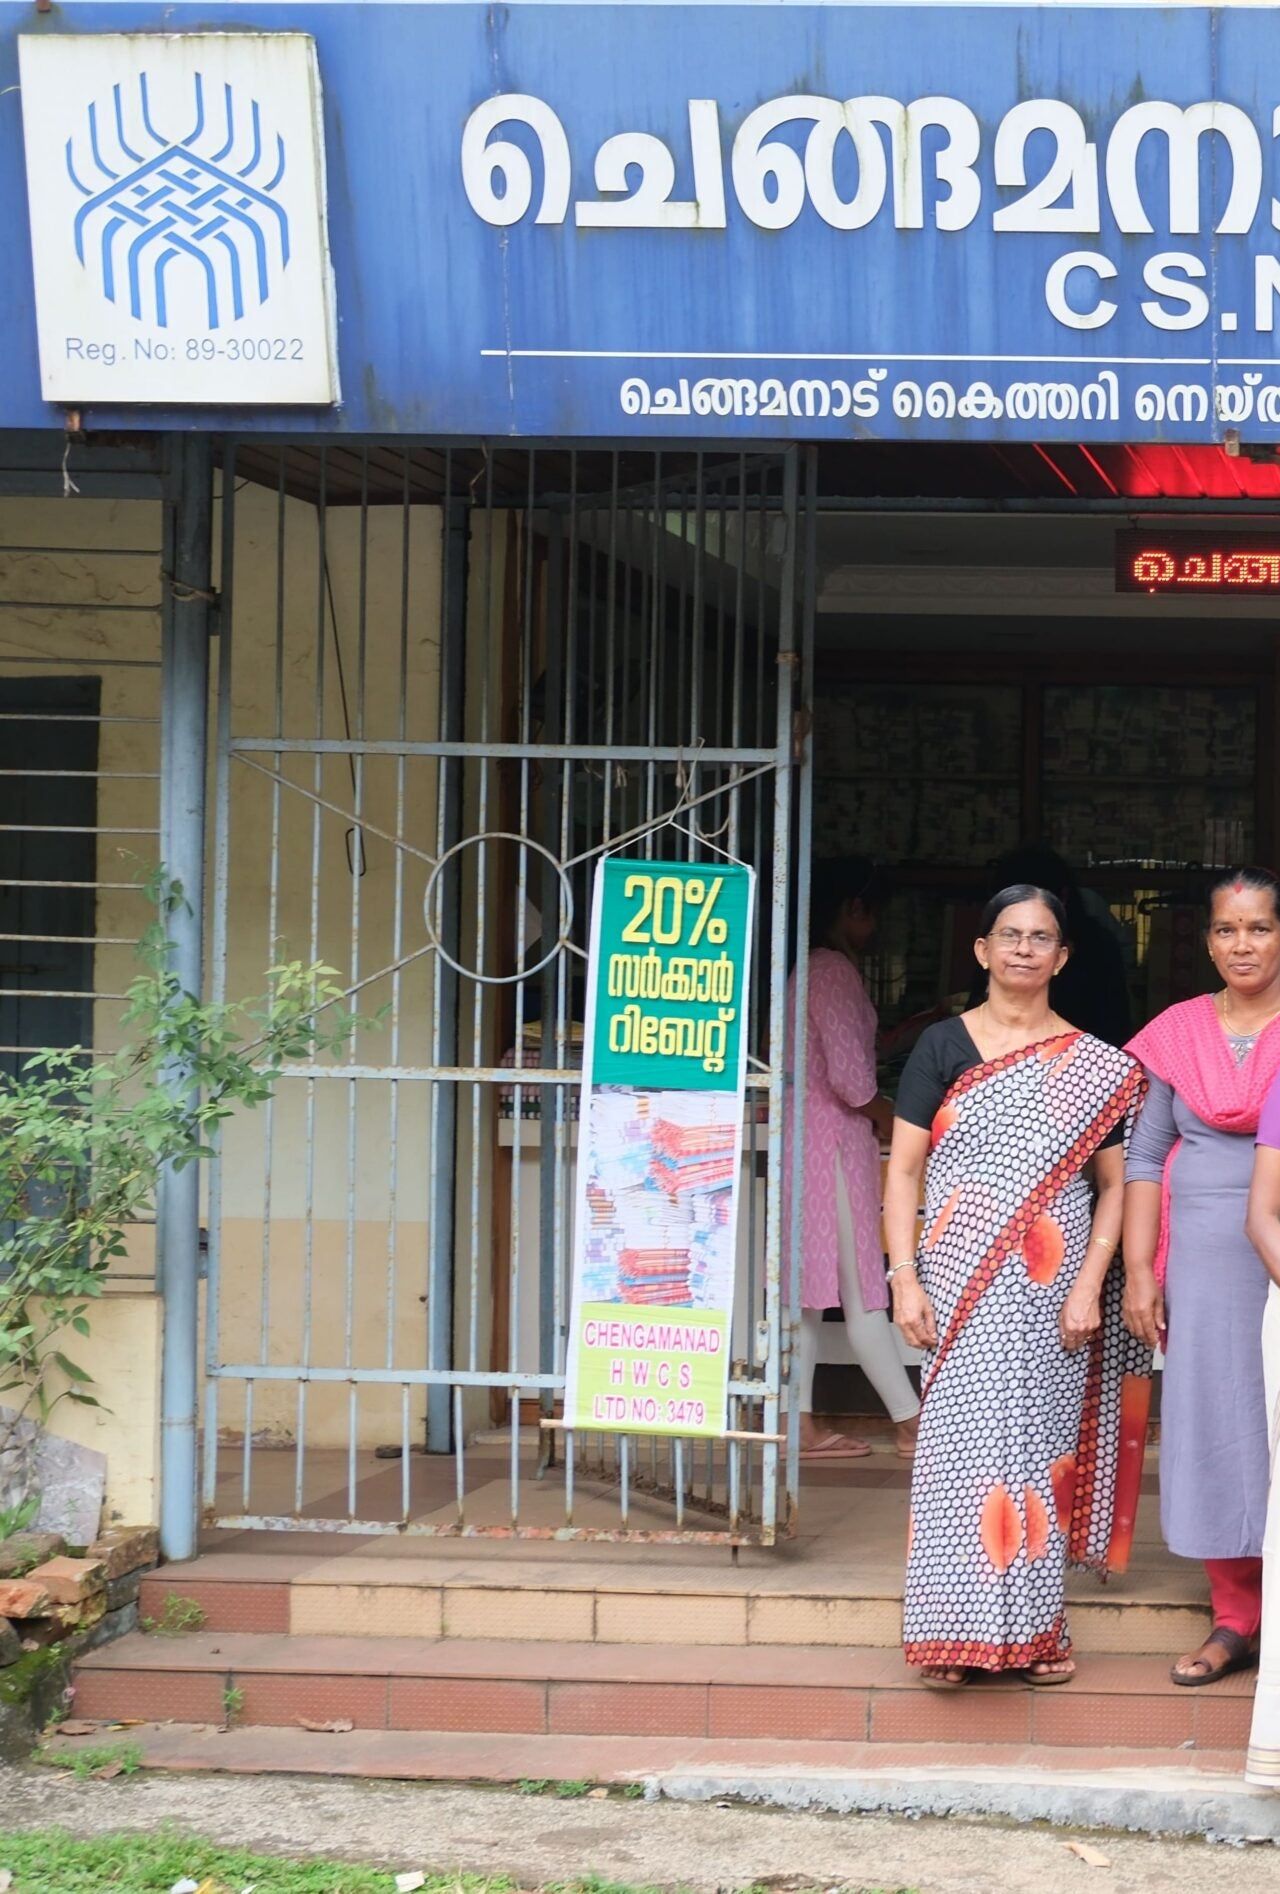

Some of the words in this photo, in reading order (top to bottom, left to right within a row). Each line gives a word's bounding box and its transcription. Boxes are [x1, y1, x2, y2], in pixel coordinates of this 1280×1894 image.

[134, 337, 176, 361] No:
[185, 338, 304, 361] 89-30022
[619, 368, 888, 418] ചെങ്ങമനാട്
[892, 370, 1120, 421] കൈത്തറി
[621, 874, 728, 946] 20%
[607, 947, 735, 1004] സർക്കാർ
[608, 1004, 736, 1073] റിബേറ്റ്
[584, 1321, 721, 1353] CHENGAMANAD
[593, 1396, 627, 1421] LTD
[632, 1397, 662, 1422] NO:
[667, 1399, 704, 1425] 3479
